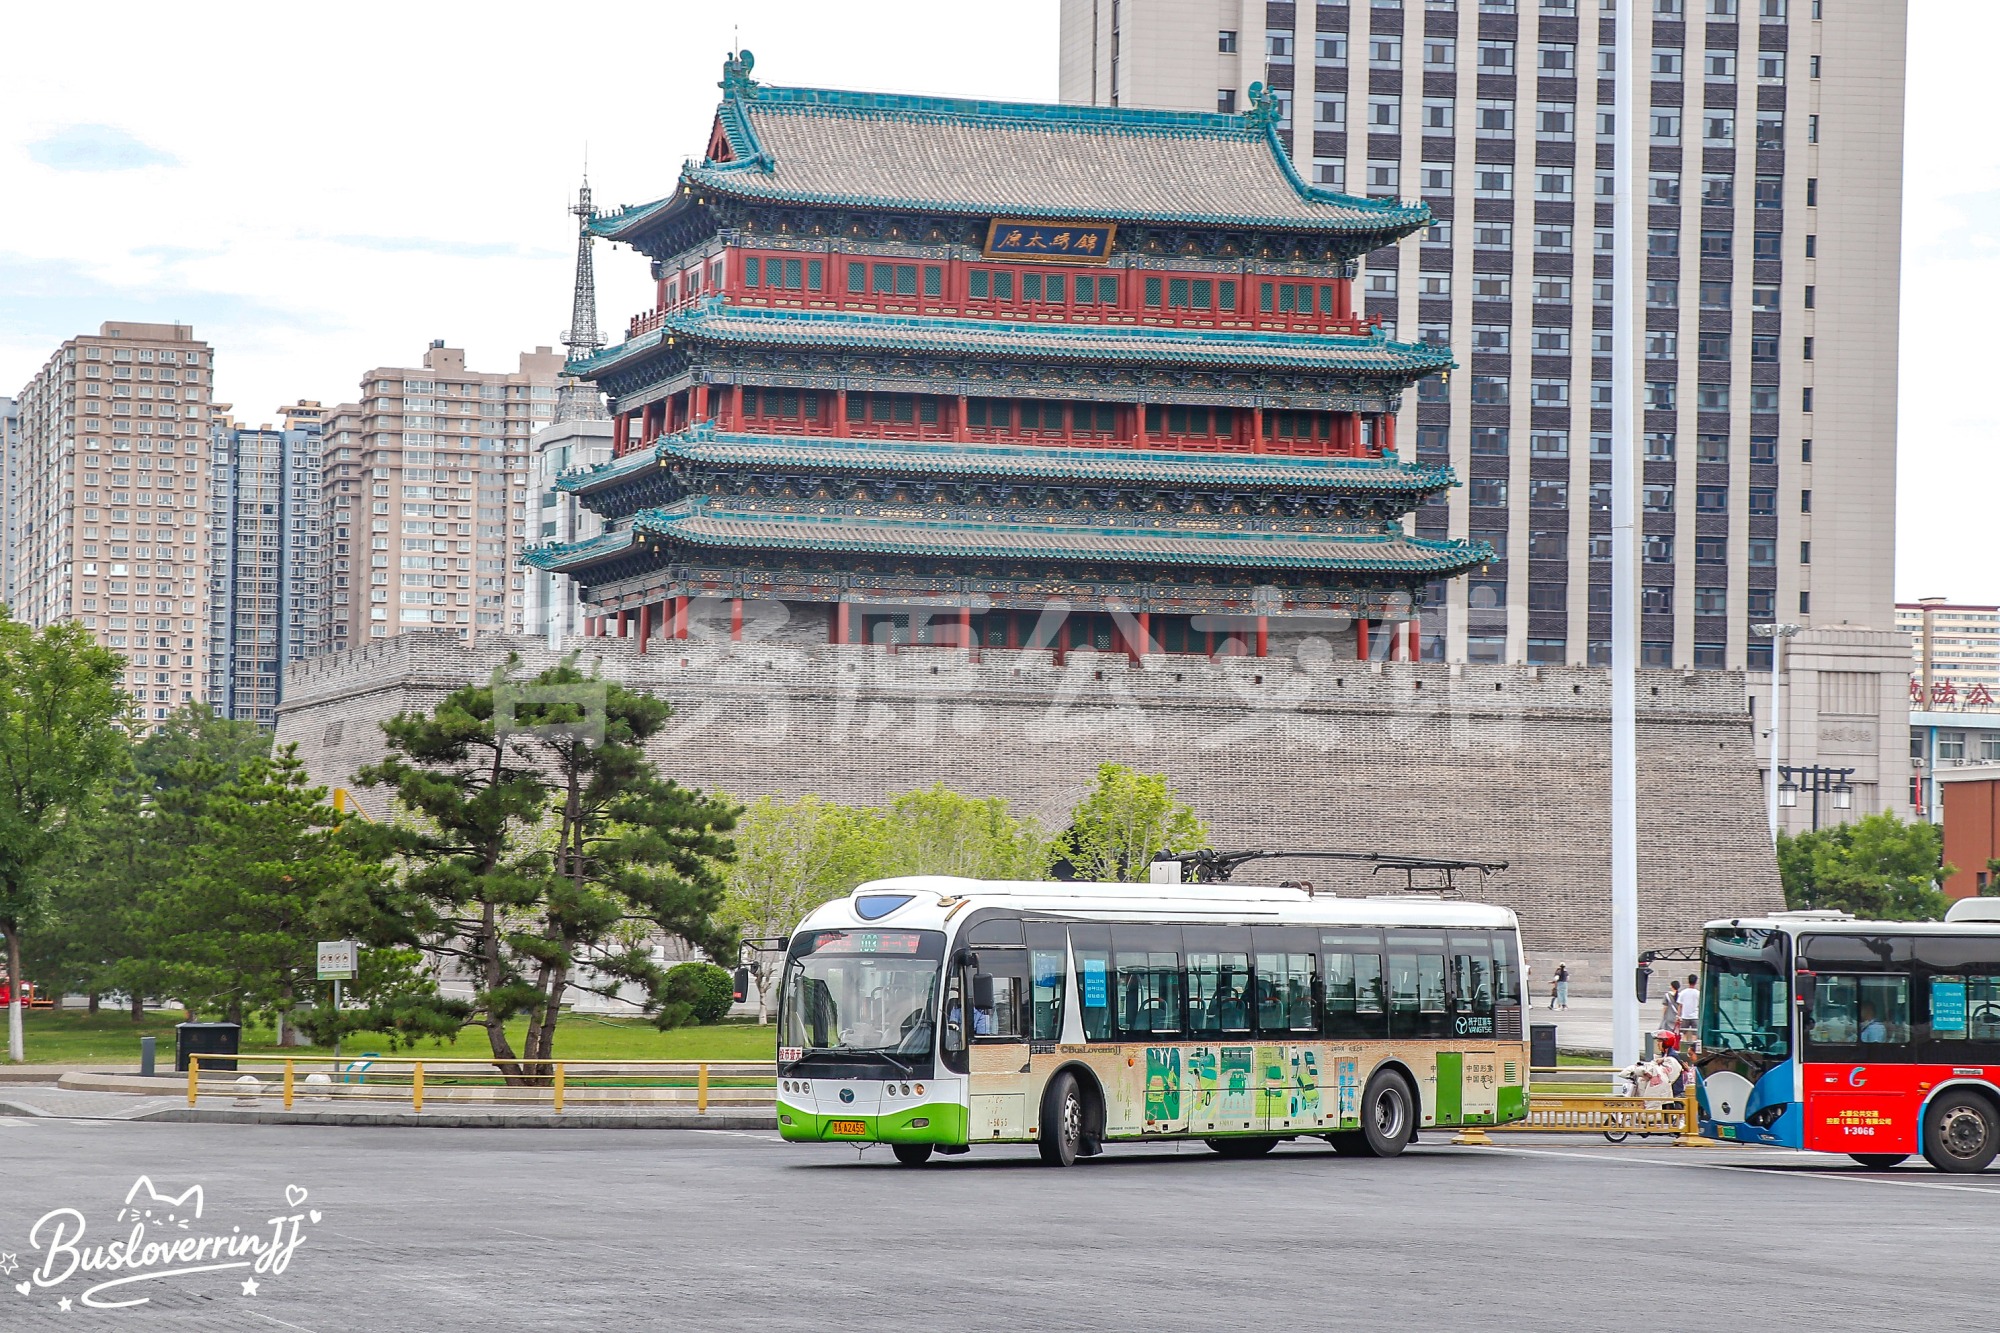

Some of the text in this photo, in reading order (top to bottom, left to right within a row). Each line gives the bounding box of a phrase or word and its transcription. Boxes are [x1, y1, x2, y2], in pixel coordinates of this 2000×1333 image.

[1466, 1064, 1494, 1073] 中国形象
[1843, 1126, 1875, 1136] 1-3066
